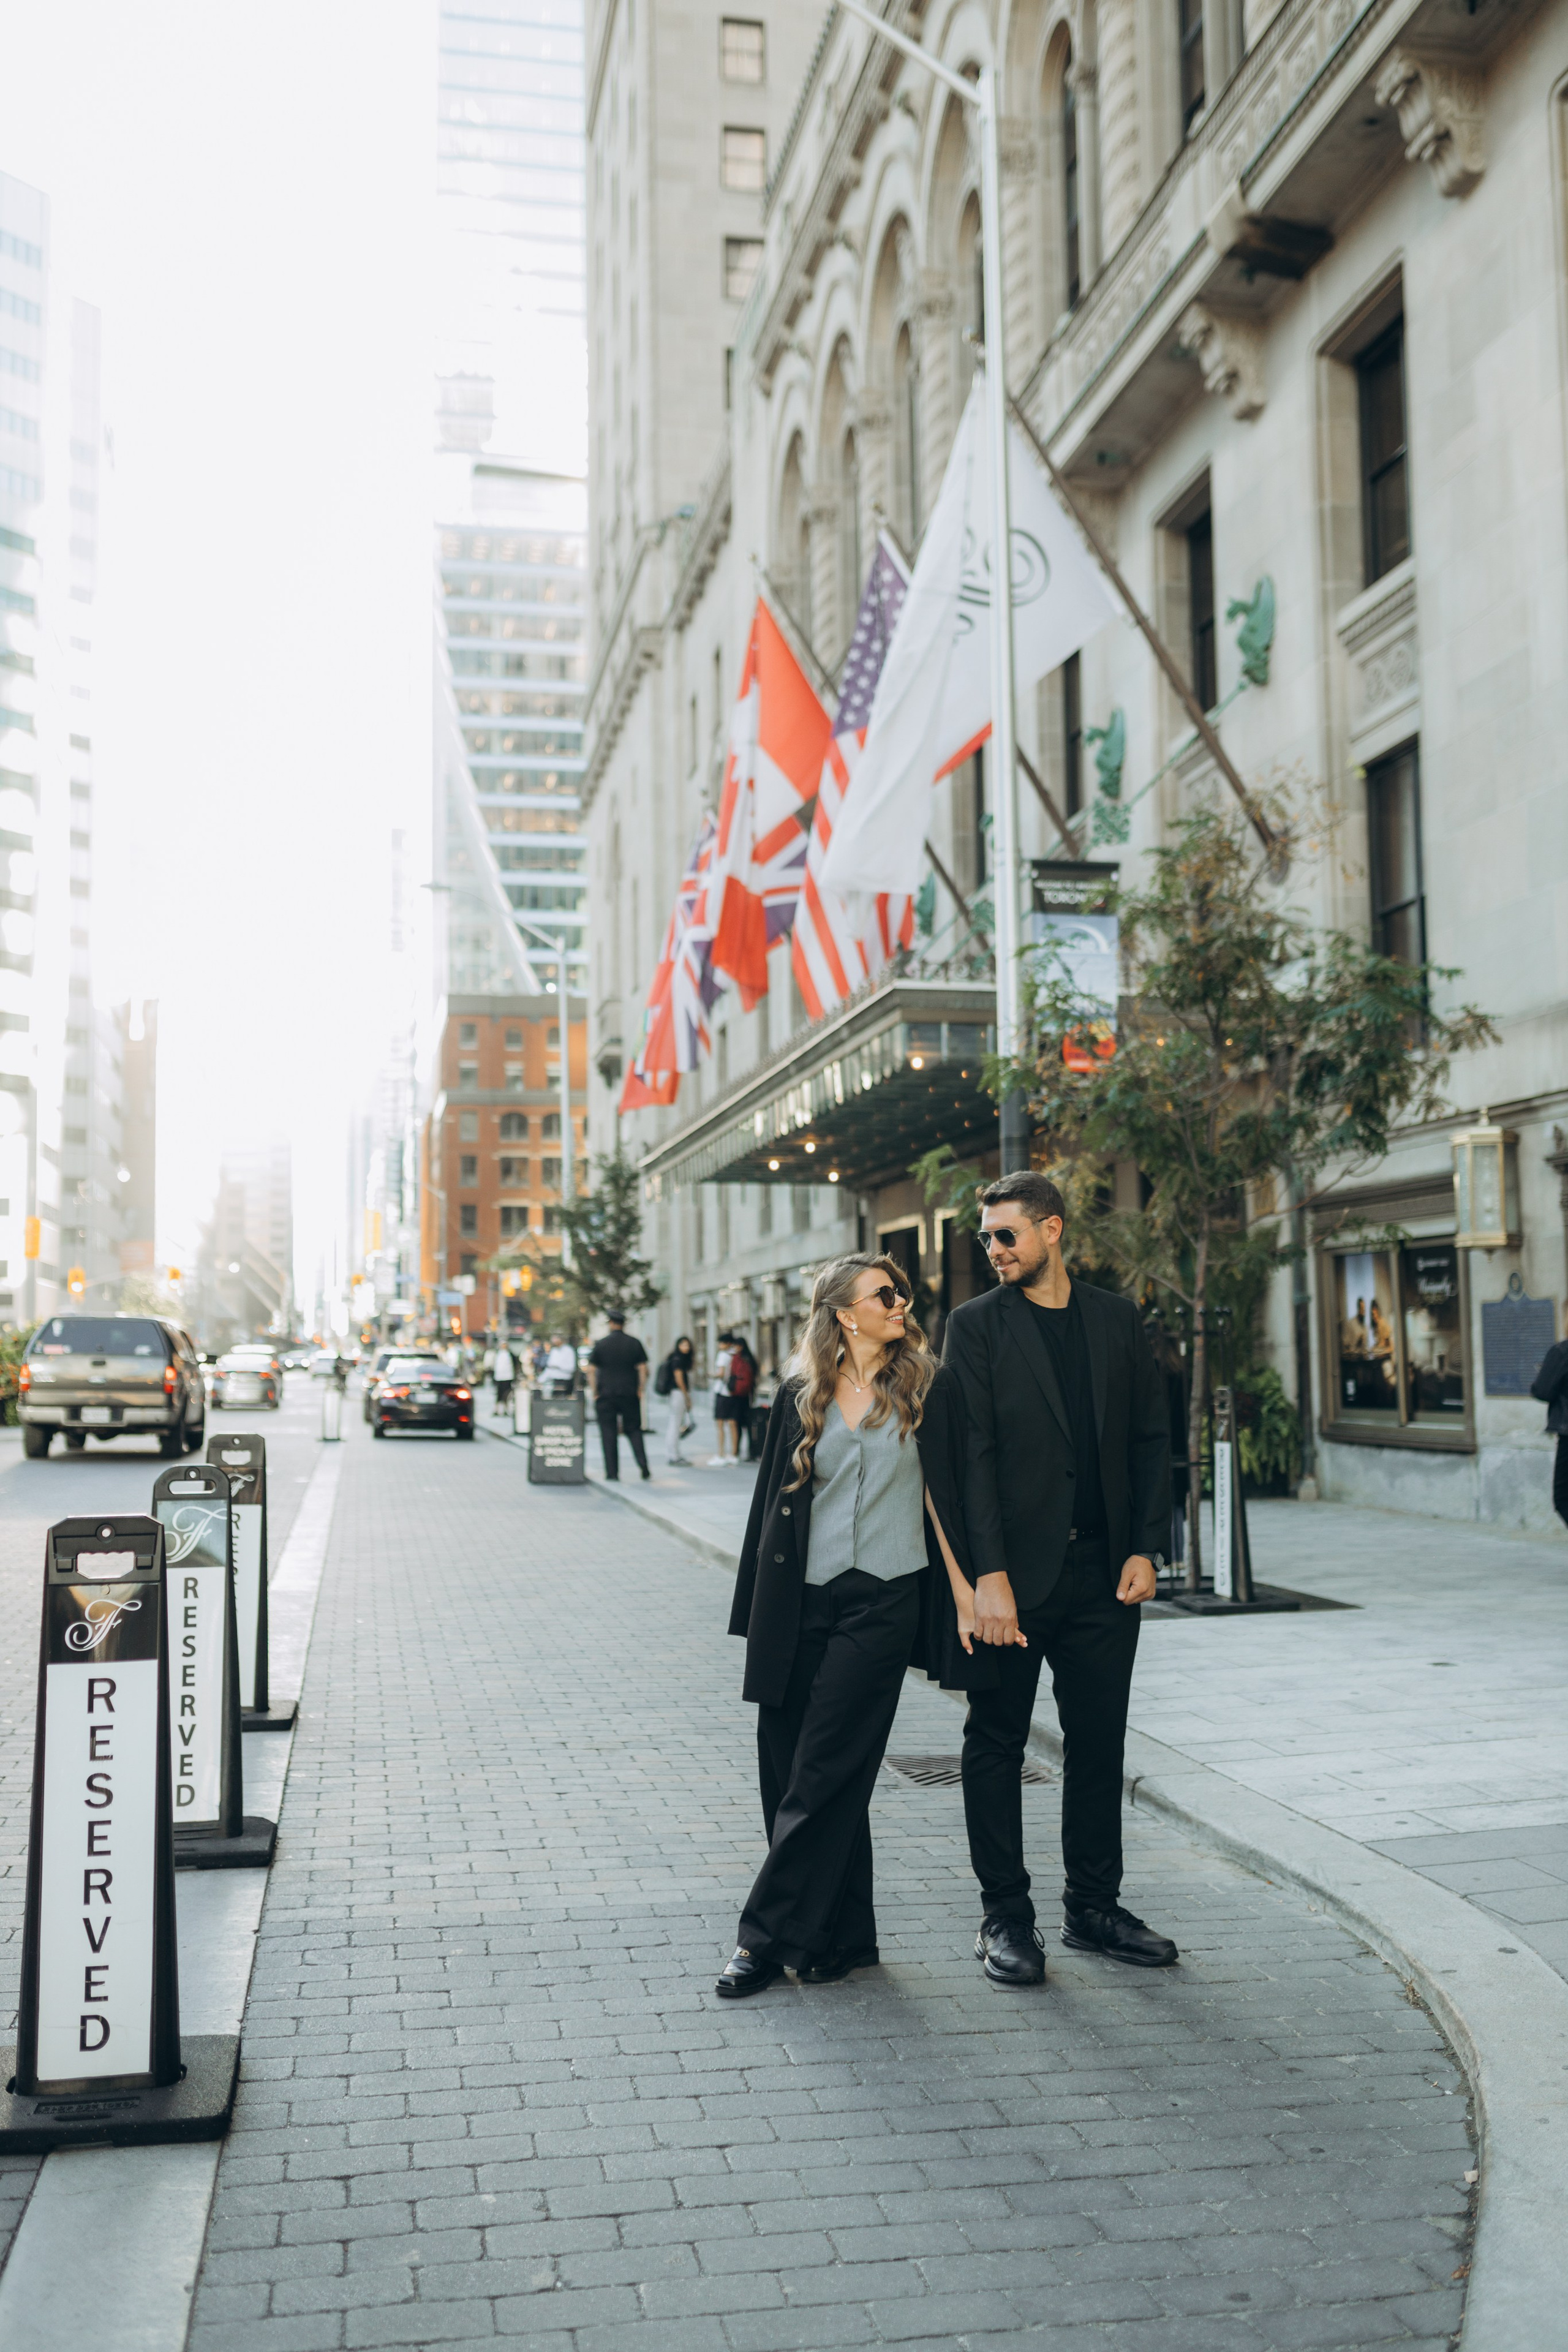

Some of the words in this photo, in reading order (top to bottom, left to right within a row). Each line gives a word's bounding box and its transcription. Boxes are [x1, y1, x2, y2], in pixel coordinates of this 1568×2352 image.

[1042, 889, 1105, 905] TORONO
[176, 1577, 199, 1807] RESERVED
[79, 1677, 117, 2052] RESERVED
